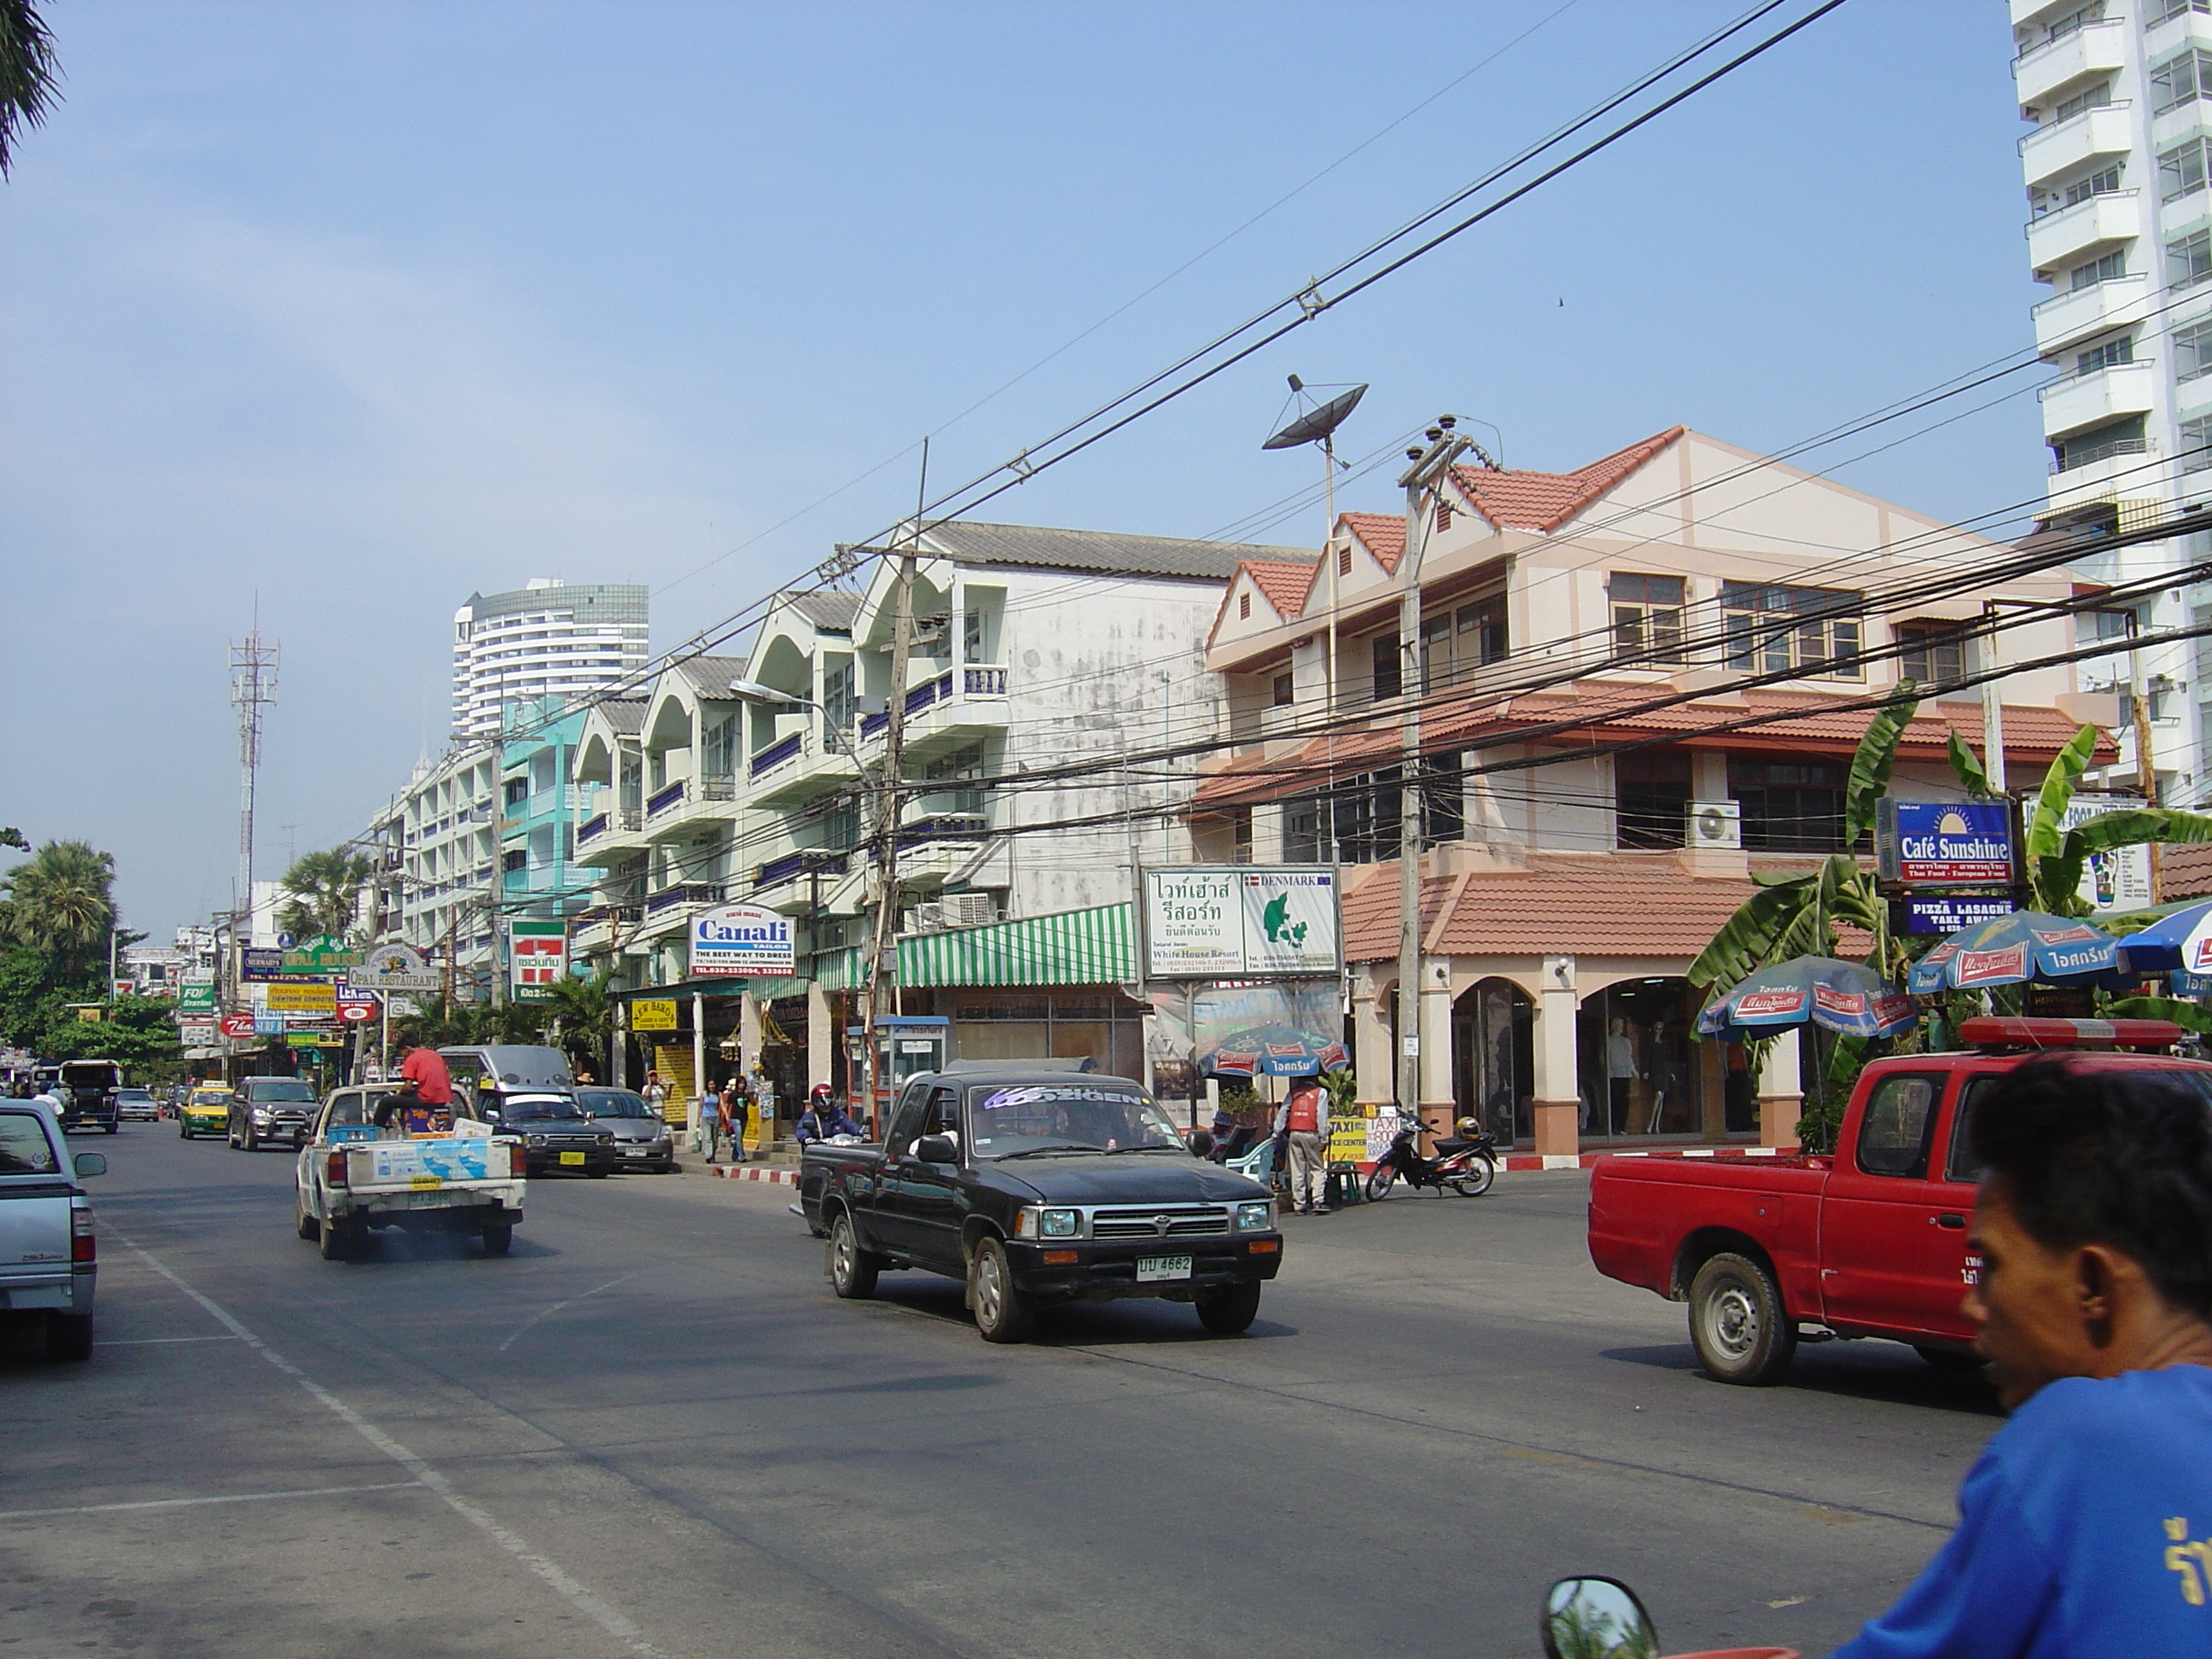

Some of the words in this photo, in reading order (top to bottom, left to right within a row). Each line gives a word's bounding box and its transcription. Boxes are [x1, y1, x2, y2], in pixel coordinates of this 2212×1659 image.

[1901, 835, 1936, 859] Café
[1940, 837, 2008, 860] Sunshine
[1260, 876, 1316, 886] DENMARK
[1162, 899, 1221, 921] รีสอร์ท
[1912, 905, 1951, 915] PIZZA
[1957, 905, 2012, 915] LASAGNE
[1930, 916, 1961, 924] TAKE
[699, 920, 788, 941] Canali
[284, 952, 316, 966] OPAL
[319, 952, 361, 966] HOUSE
[1153, 950, 1181, 958] White
[1211, 949, 1239, 958] Resort
[2048, 946, 2109, 969] ไอศกรีม
[350, 970, 375, 986] OPAL
[377, 974, 438, 987] RESTAURANT
[1272, 1061, 1310, 1072] ไอศกรีม
[1330, 1121, 1353, 1133] TAXI
[1371, 1117, 1400, 1131] TAXI
[1161, 1257, 1190, 1270] 4662
